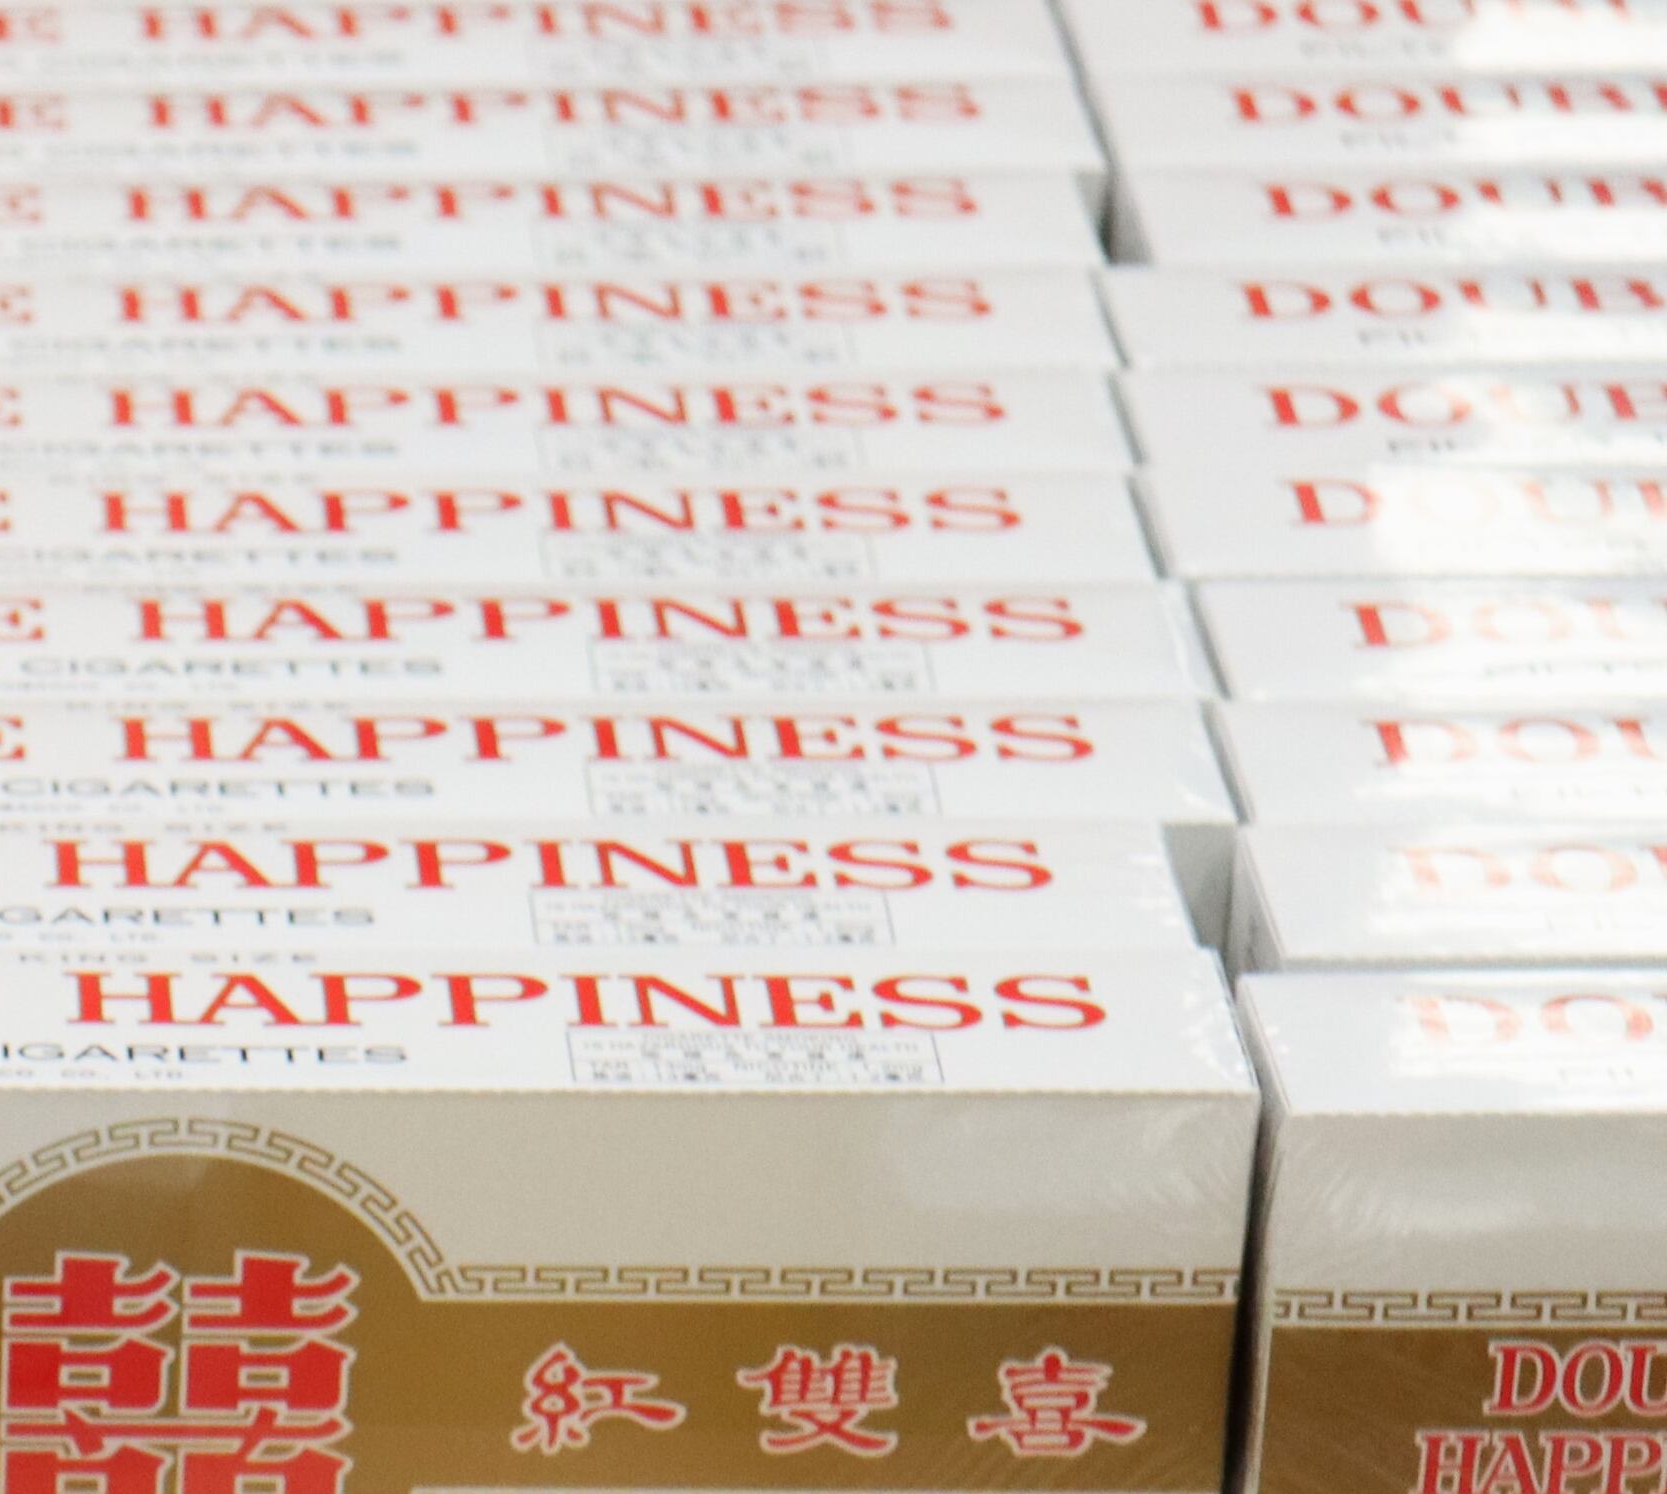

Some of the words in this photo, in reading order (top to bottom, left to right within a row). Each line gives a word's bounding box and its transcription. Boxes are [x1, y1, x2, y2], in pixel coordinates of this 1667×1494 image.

[139, 0, 954, 42] HAPPINESS
[147, 84, 982, 131] HAPPINESS
[126, 178, 981, 224] HAPPINESS
[116, 279, 994, 325] HAPPINESS
[107, 381, 1009, 430] HAPPINESS
[98, 486, 1025, 536] HAPPINESS
[133, 593, 1087, 644] HAPPINESS
[21, 660, 442, 676] CIGARETTES
[116, 711, 1097, 764] HAPPINESS
[1, 781, 434, 797] CIGARETTES
[43, 836, 1056, 892] HAPPINESS
[66, 967, 1109, 1032] HAPPINESS
[510, 1341, 1147, 1458] 紅雙喜
